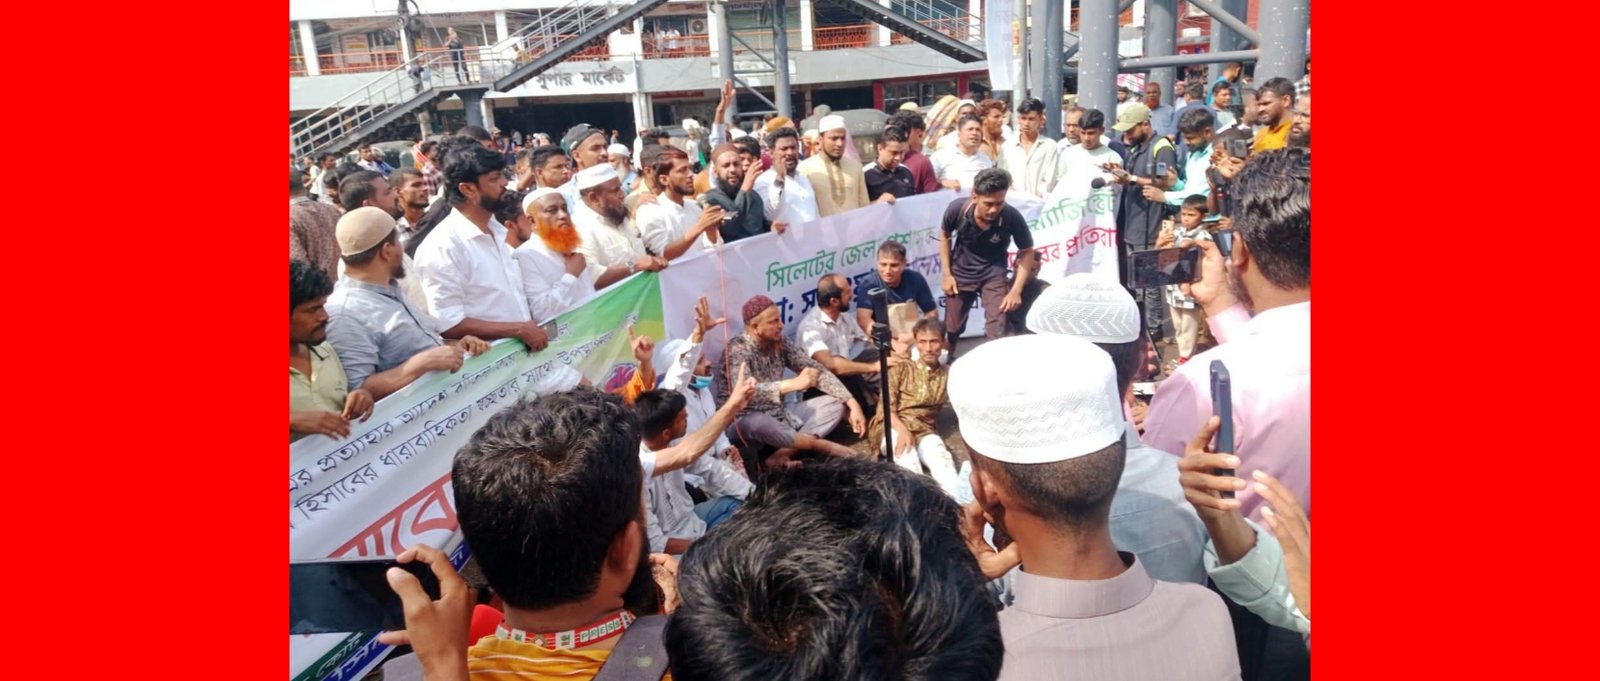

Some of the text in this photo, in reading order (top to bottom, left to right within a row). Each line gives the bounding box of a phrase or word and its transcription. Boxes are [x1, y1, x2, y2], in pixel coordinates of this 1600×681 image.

[766, 249, 837, 291] সিলেটের
[841, 240, 877, 267] জেল
[1066, 225, 1118, 257] প্রতিবা
[294, 462, 379, 520] হিসাবের
[379, 404, 472, 467] ধারাবাহিকতা
[521, 359, 553, 384] সাথে
[316, 421, 394, 472] প্রত্যাহার
[579, 617, 622, 643] PRESS
